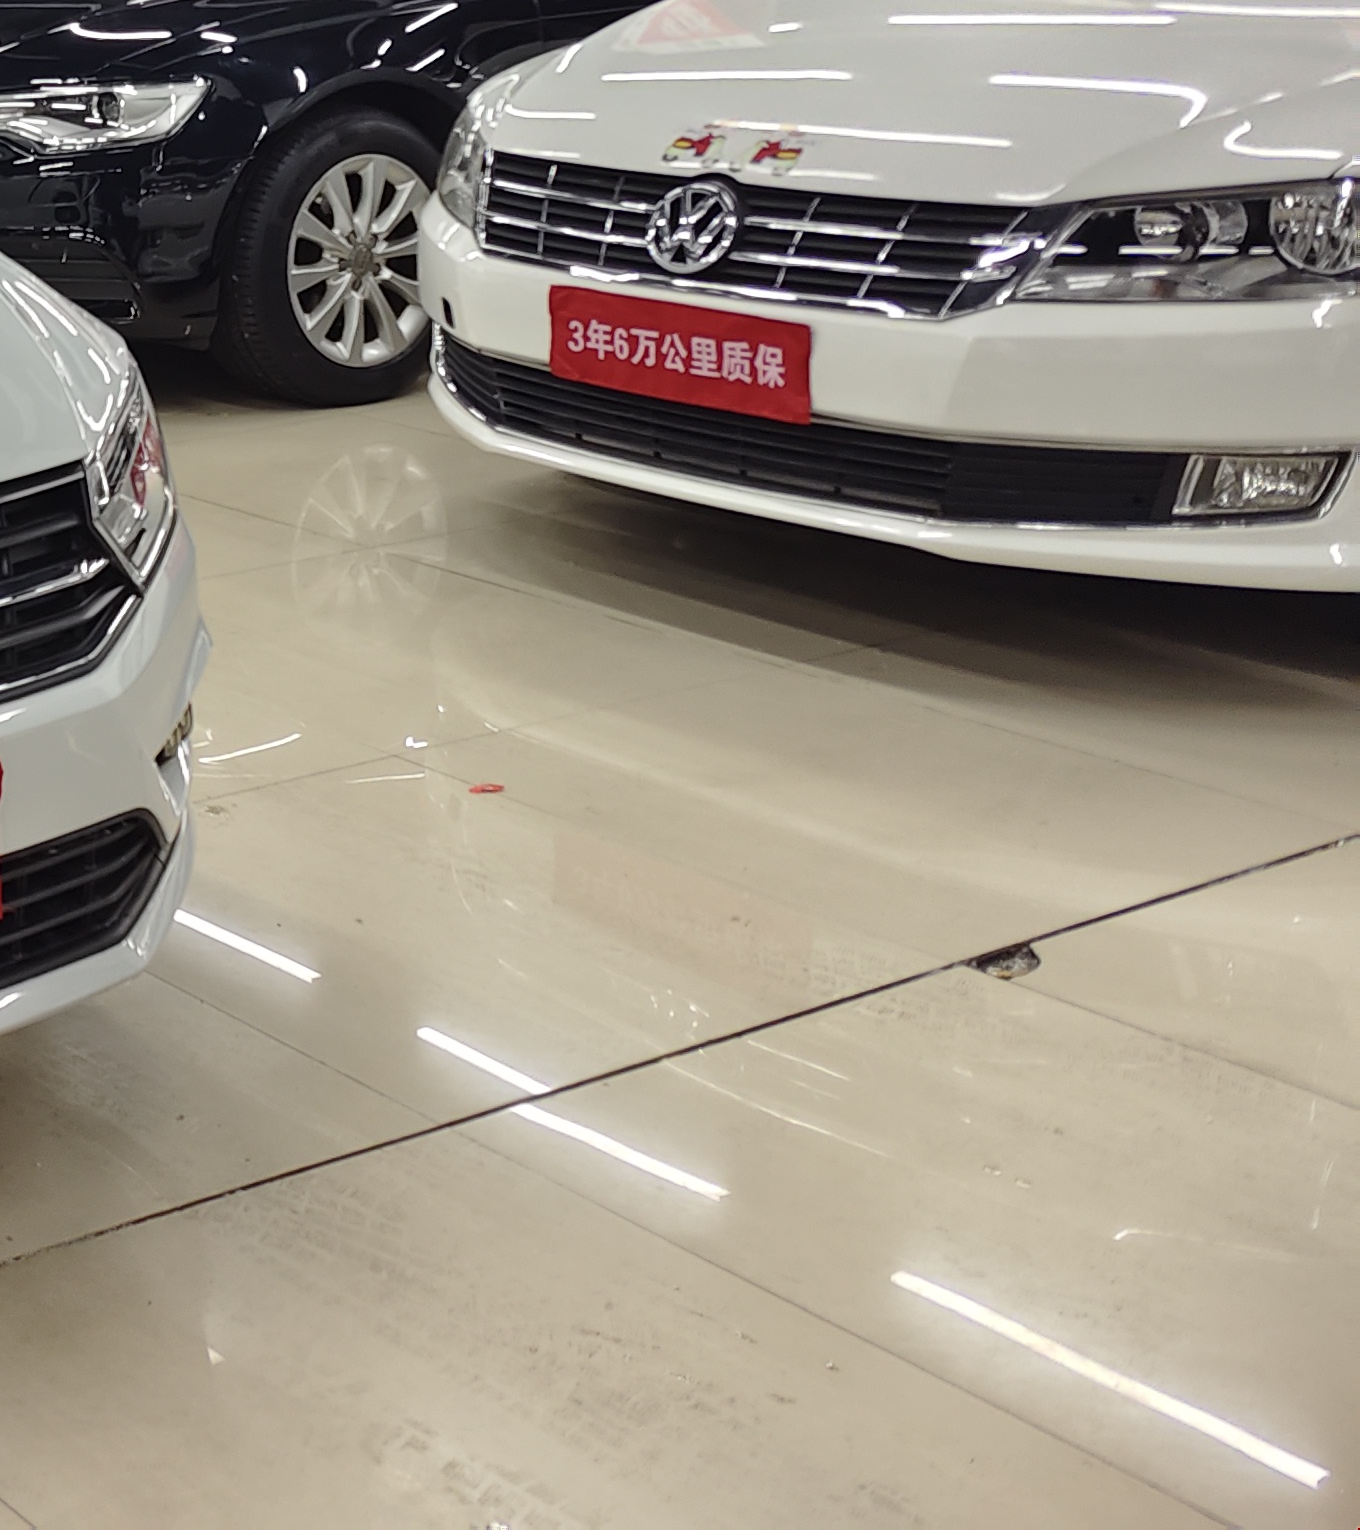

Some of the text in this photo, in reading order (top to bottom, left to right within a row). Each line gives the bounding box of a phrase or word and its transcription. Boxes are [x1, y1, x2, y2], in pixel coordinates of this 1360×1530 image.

[567, 319, 786, 388] 3年6万公里质保
